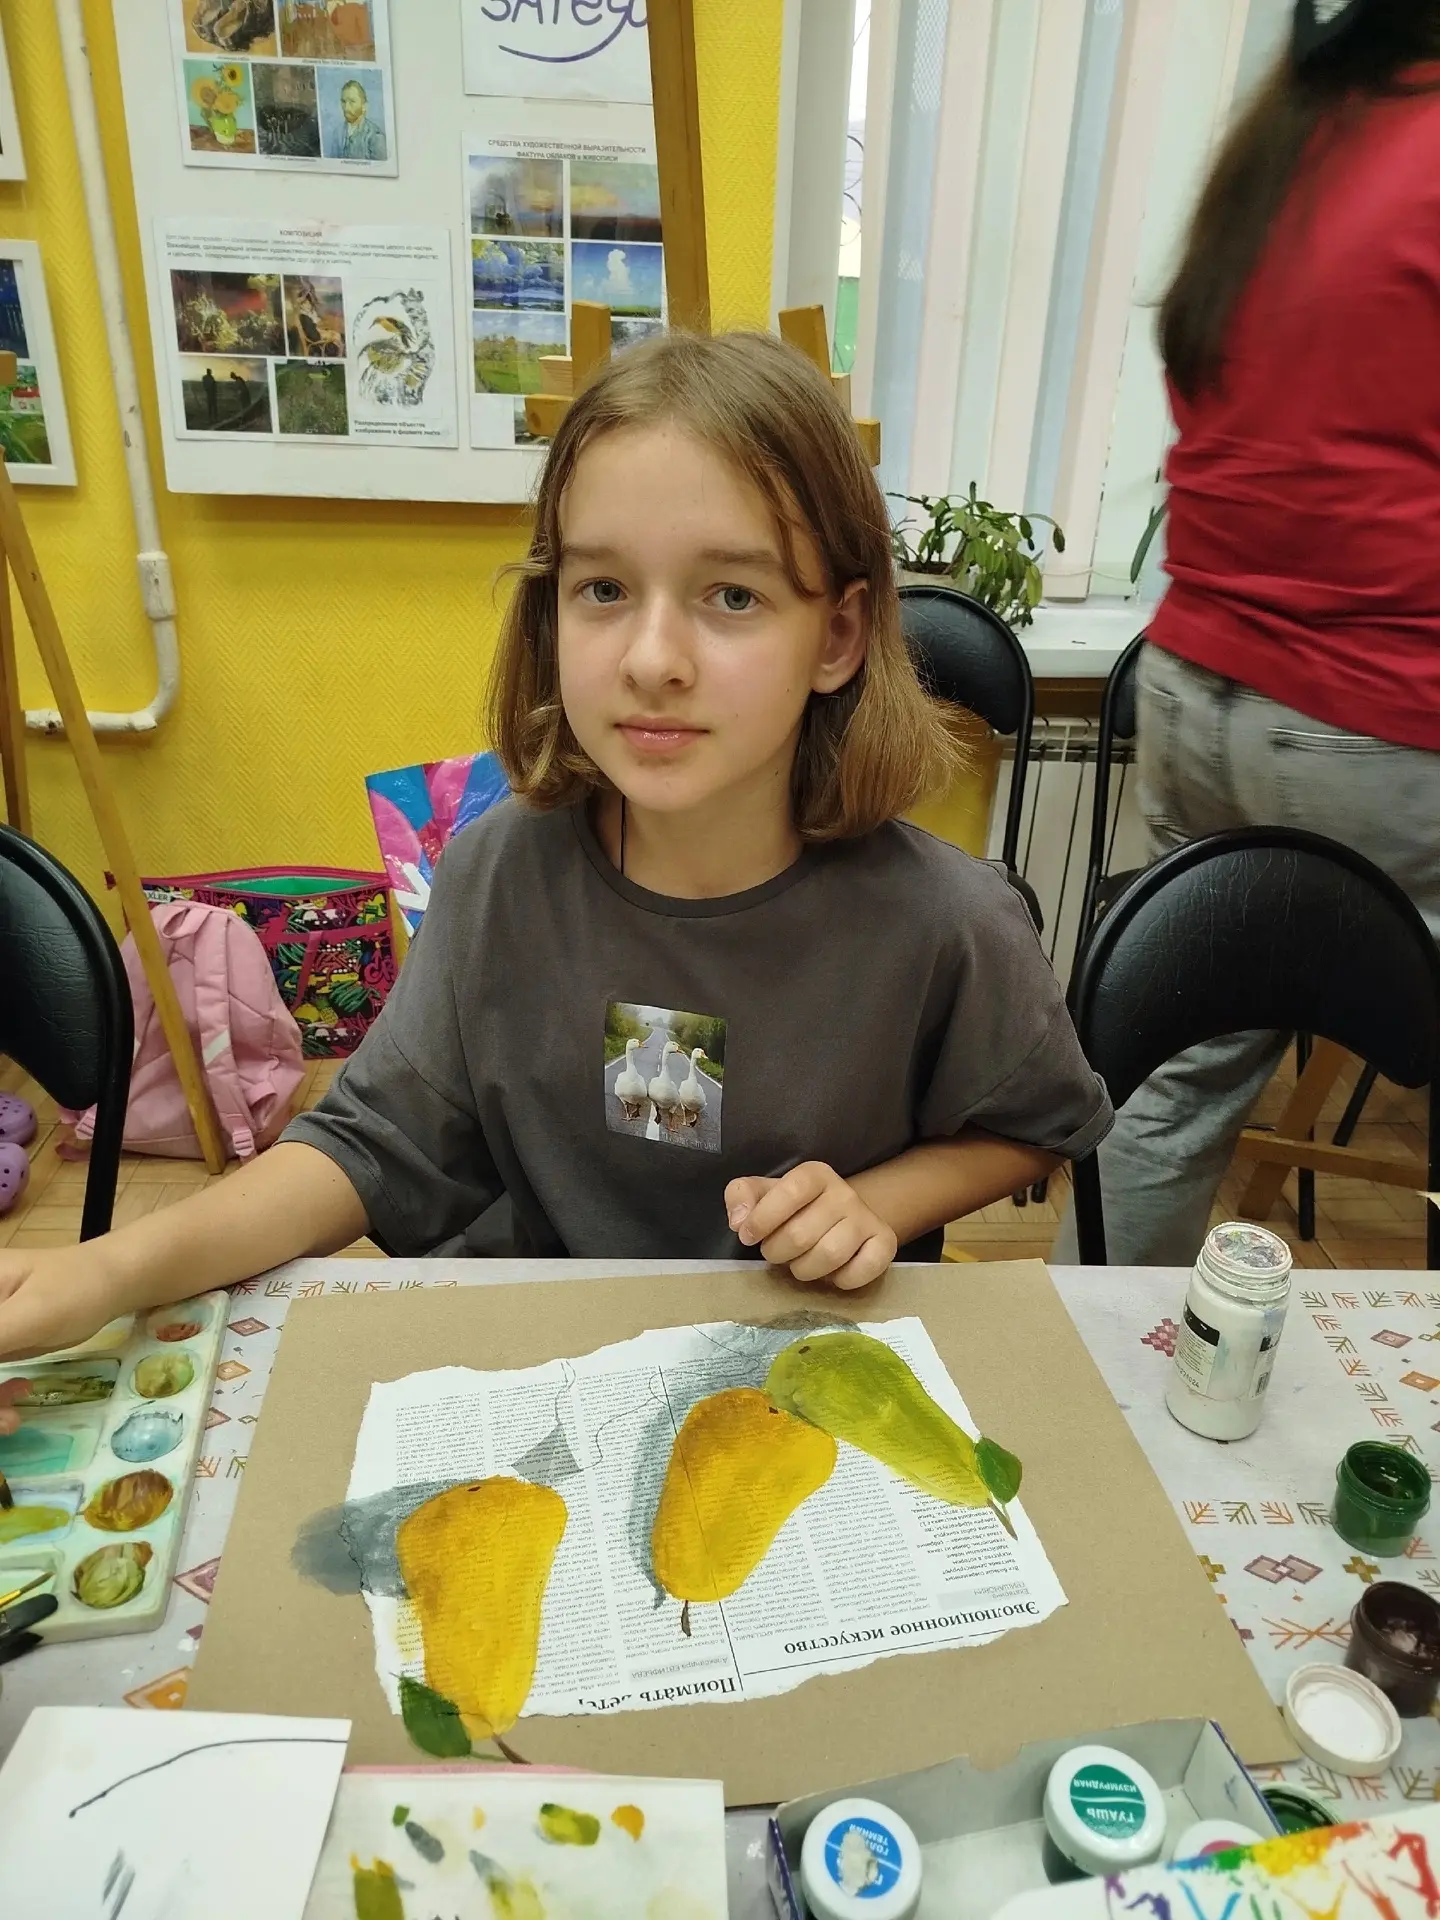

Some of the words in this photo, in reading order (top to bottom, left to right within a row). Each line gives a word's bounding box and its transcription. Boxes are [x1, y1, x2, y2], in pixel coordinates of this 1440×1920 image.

[890, 1601, 1040, 1637] Эволюционное
[784, 1626, 885, 1654] искусство
[1073, 1779, 1137, 1793] ИЗУМРУДНАЯ
[1086, 1808, 1136, 1824] ГУАШЬ
